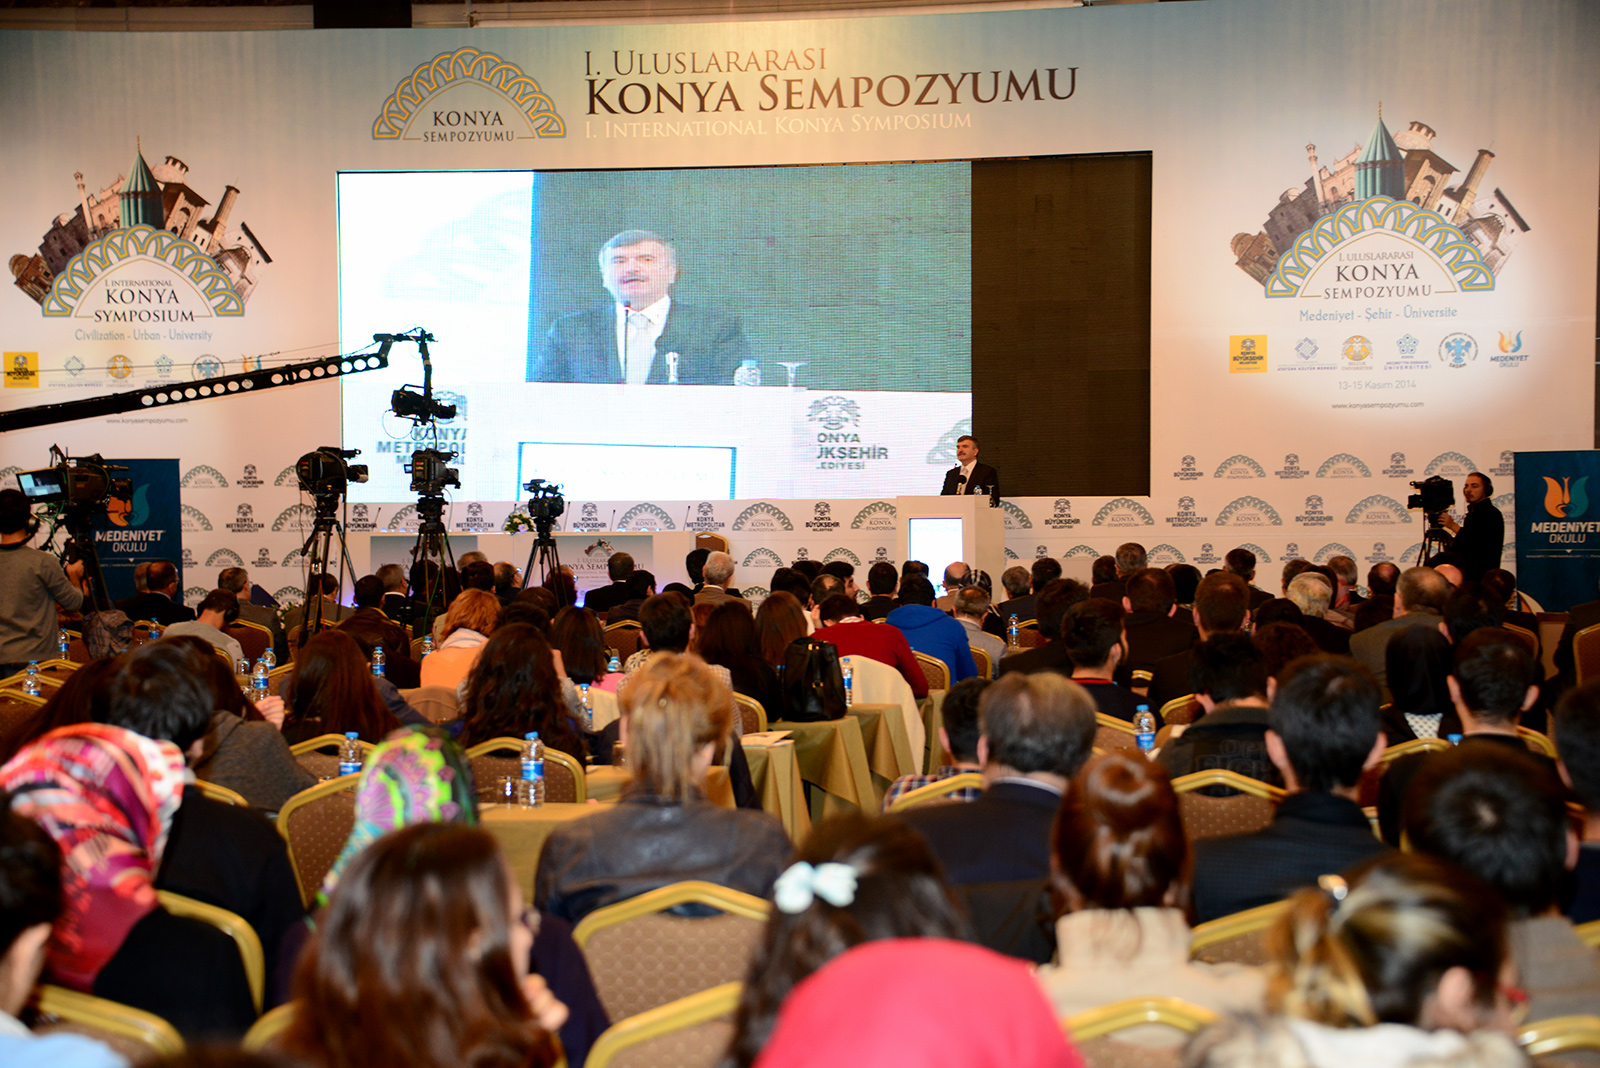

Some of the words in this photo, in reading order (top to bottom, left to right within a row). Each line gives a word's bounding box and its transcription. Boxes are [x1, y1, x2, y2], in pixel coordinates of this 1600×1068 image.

[613, 48, 827, 76] ULUSLARARASI
[585, 79, 745, 115] KONYA
[759, 67, 1079, 112] SEMPOZYUMU
[433, 111, 504, 126] KONYA
[605, 120, 767, 138] INTERNATIONAL
[774, 117, 844, 134] KONYA
[852, 113, 972, 132] SYMPOSIUM
[424, 130, 514, 142] SEMPOZYUMU
[1347, 251, 1414, 261] ULUSLARARASI
[1336, 264, 1420, 282] KONYA
[111, 279, 173, 287] INTERNATIONAL
[106, 289, 180, 304] KONYA
[1324, 285, 1432, 300] SEMPOZYUMU
[94, 310, 195, 323] SYMPOSIUM
[1300, 310, 1355, 323] Medeniyet
[1365, 307, 1392, 322] Şehir
[1404, 304, 1458, 318] Üniversite
[75, 328, 125, 341] Civilization
[133, 329, 160, 341] Urban
[168, 329, 213, 342] University
[1338, 381, 1363, 390] 13-15
[1395, 380, 1417, 389] 2014
[1331, 401, 1424, 410] www.konyasempozyumu.com
[816, 461, 866, 470] EDİYESİ
[1549, 534, 1587, 544] OKULU
[112, 542, 147, 553] OKULU
